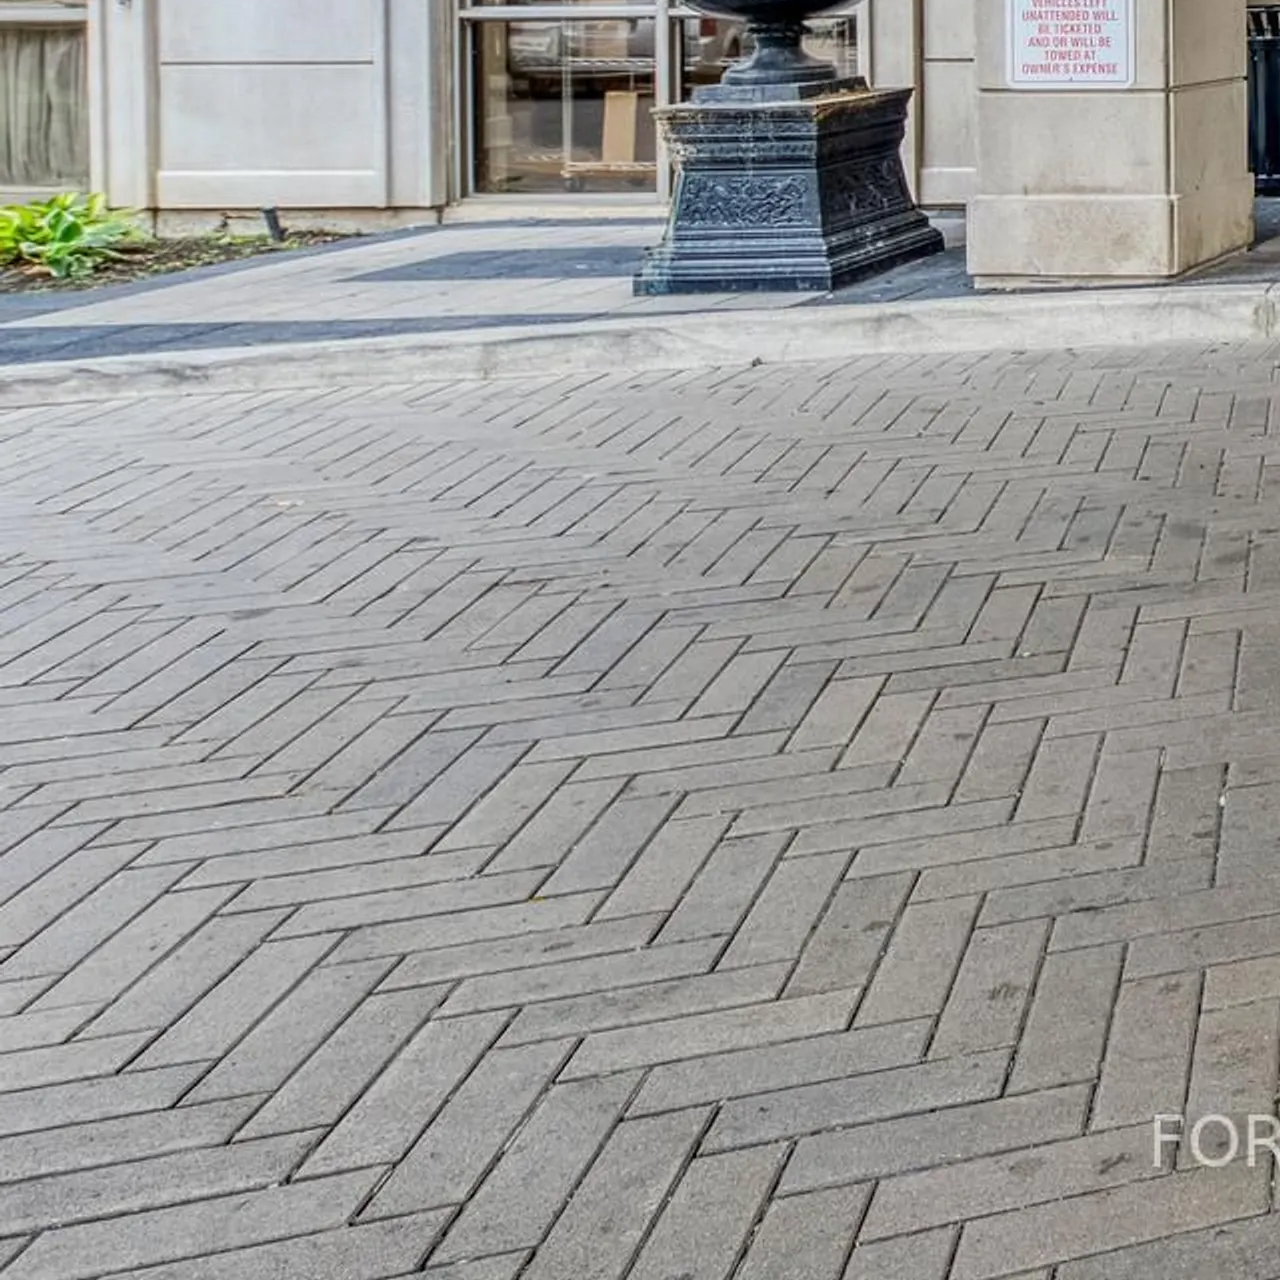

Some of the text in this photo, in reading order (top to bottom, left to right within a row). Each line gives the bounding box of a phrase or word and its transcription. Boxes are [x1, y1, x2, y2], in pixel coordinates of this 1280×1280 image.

[1022, 10, 1118, 21] UNATTENDED WILL
[1038, 24, 1101, 34] BE TICKETED
[1028, 37, 1111, 48] AND OR WILL BE
[1044, 50, 1096, 61] TOWED AT
[1073, 63, 1118, 74] EXPENSE
